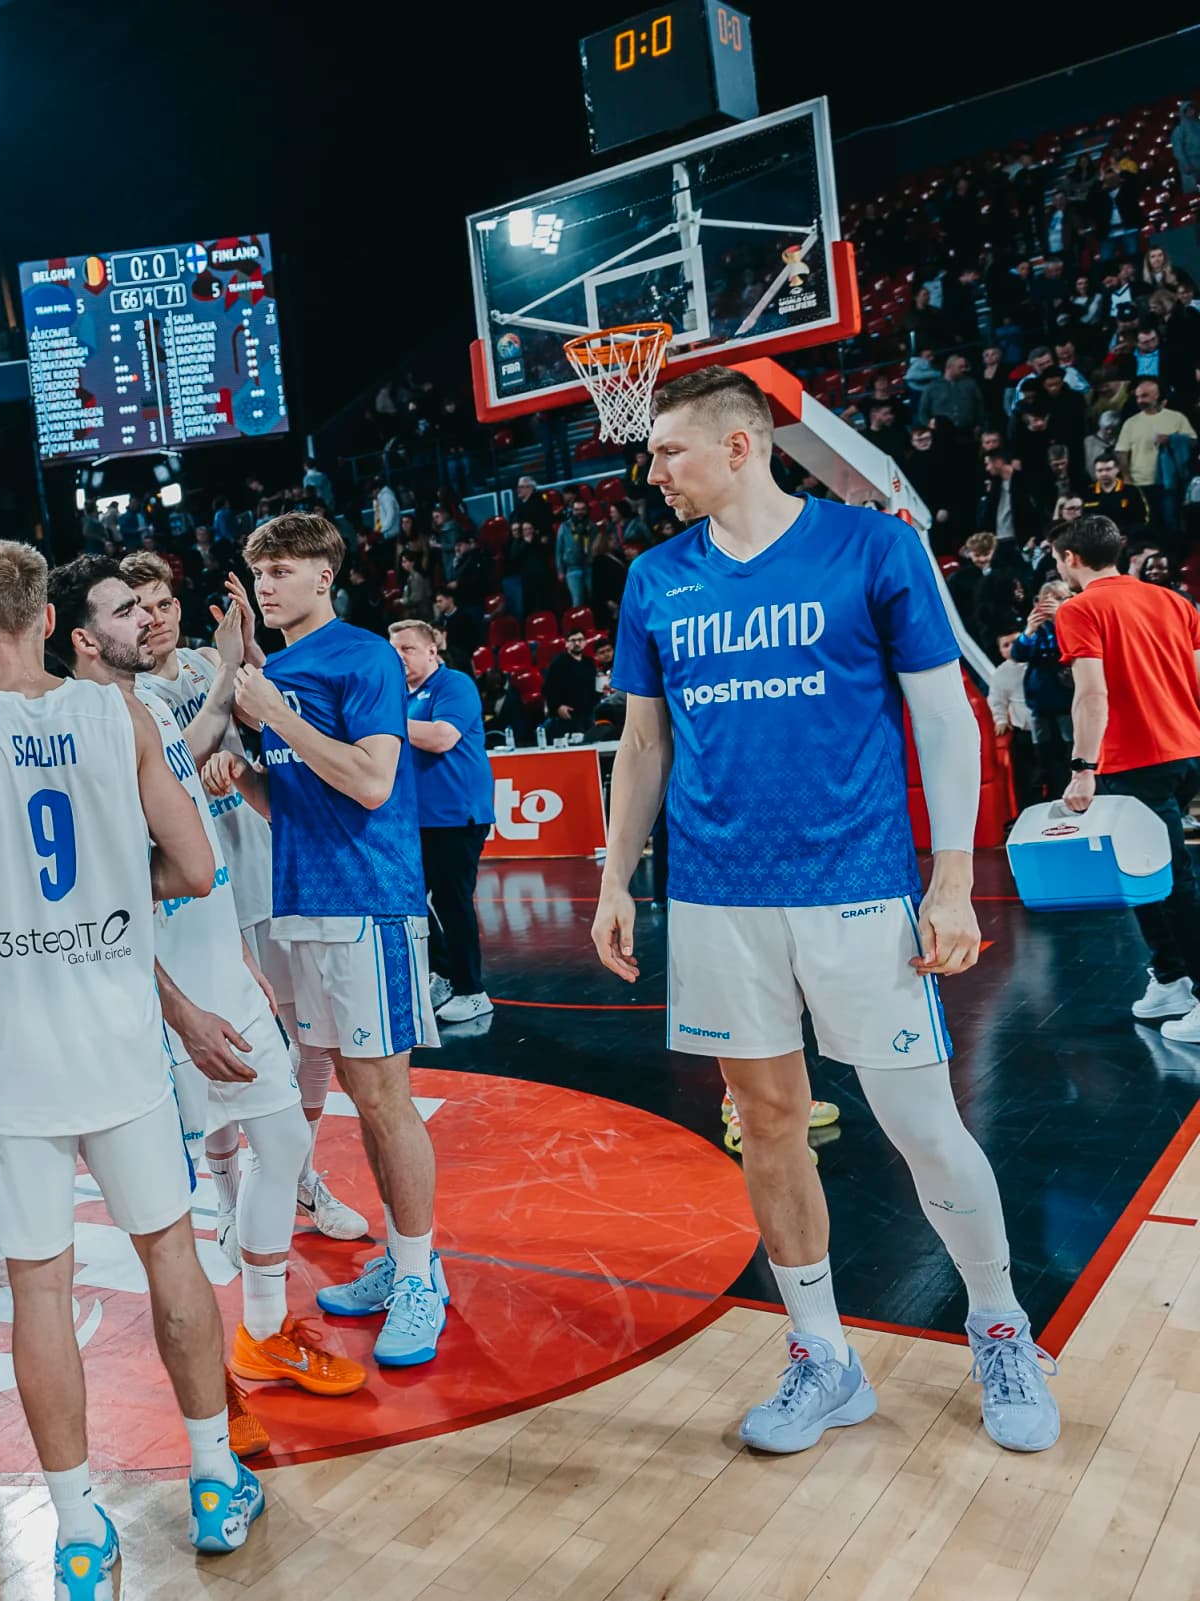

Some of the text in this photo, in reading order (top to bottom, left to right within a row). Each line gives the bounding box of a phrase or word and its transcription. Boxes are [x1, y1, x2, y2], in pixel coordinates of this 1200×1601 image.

[615, 15, 672, 71] 0:0
[211, 246, 259, 264] FINLAND
[32, 267, 76, 283] BELGIUM
[144, 291, 153, 306] 4
[165, 285, 181, 304] 71
[211, 282, 220, 298] 5
[76, 298, 85, 314] 5
[121, 291, 138, 309] 66
[173, 313, 194, 325] SALIN
[502, 361, 520, 376] FIBA
[666, 584, 696, 597] CRAFT
[671, 601, 826, 661] FINLAND
[683, 670, 826, 711] postnord
[12, 733, 77, 768] SALIN
[485, 778, 564, 841] to
[27, 788, 77, 902] 9
[841, 905, 878, 919] CRAFT
[67, 946, 133, 965] Go full circle
[678, 1023, 731, 1041] postnord
